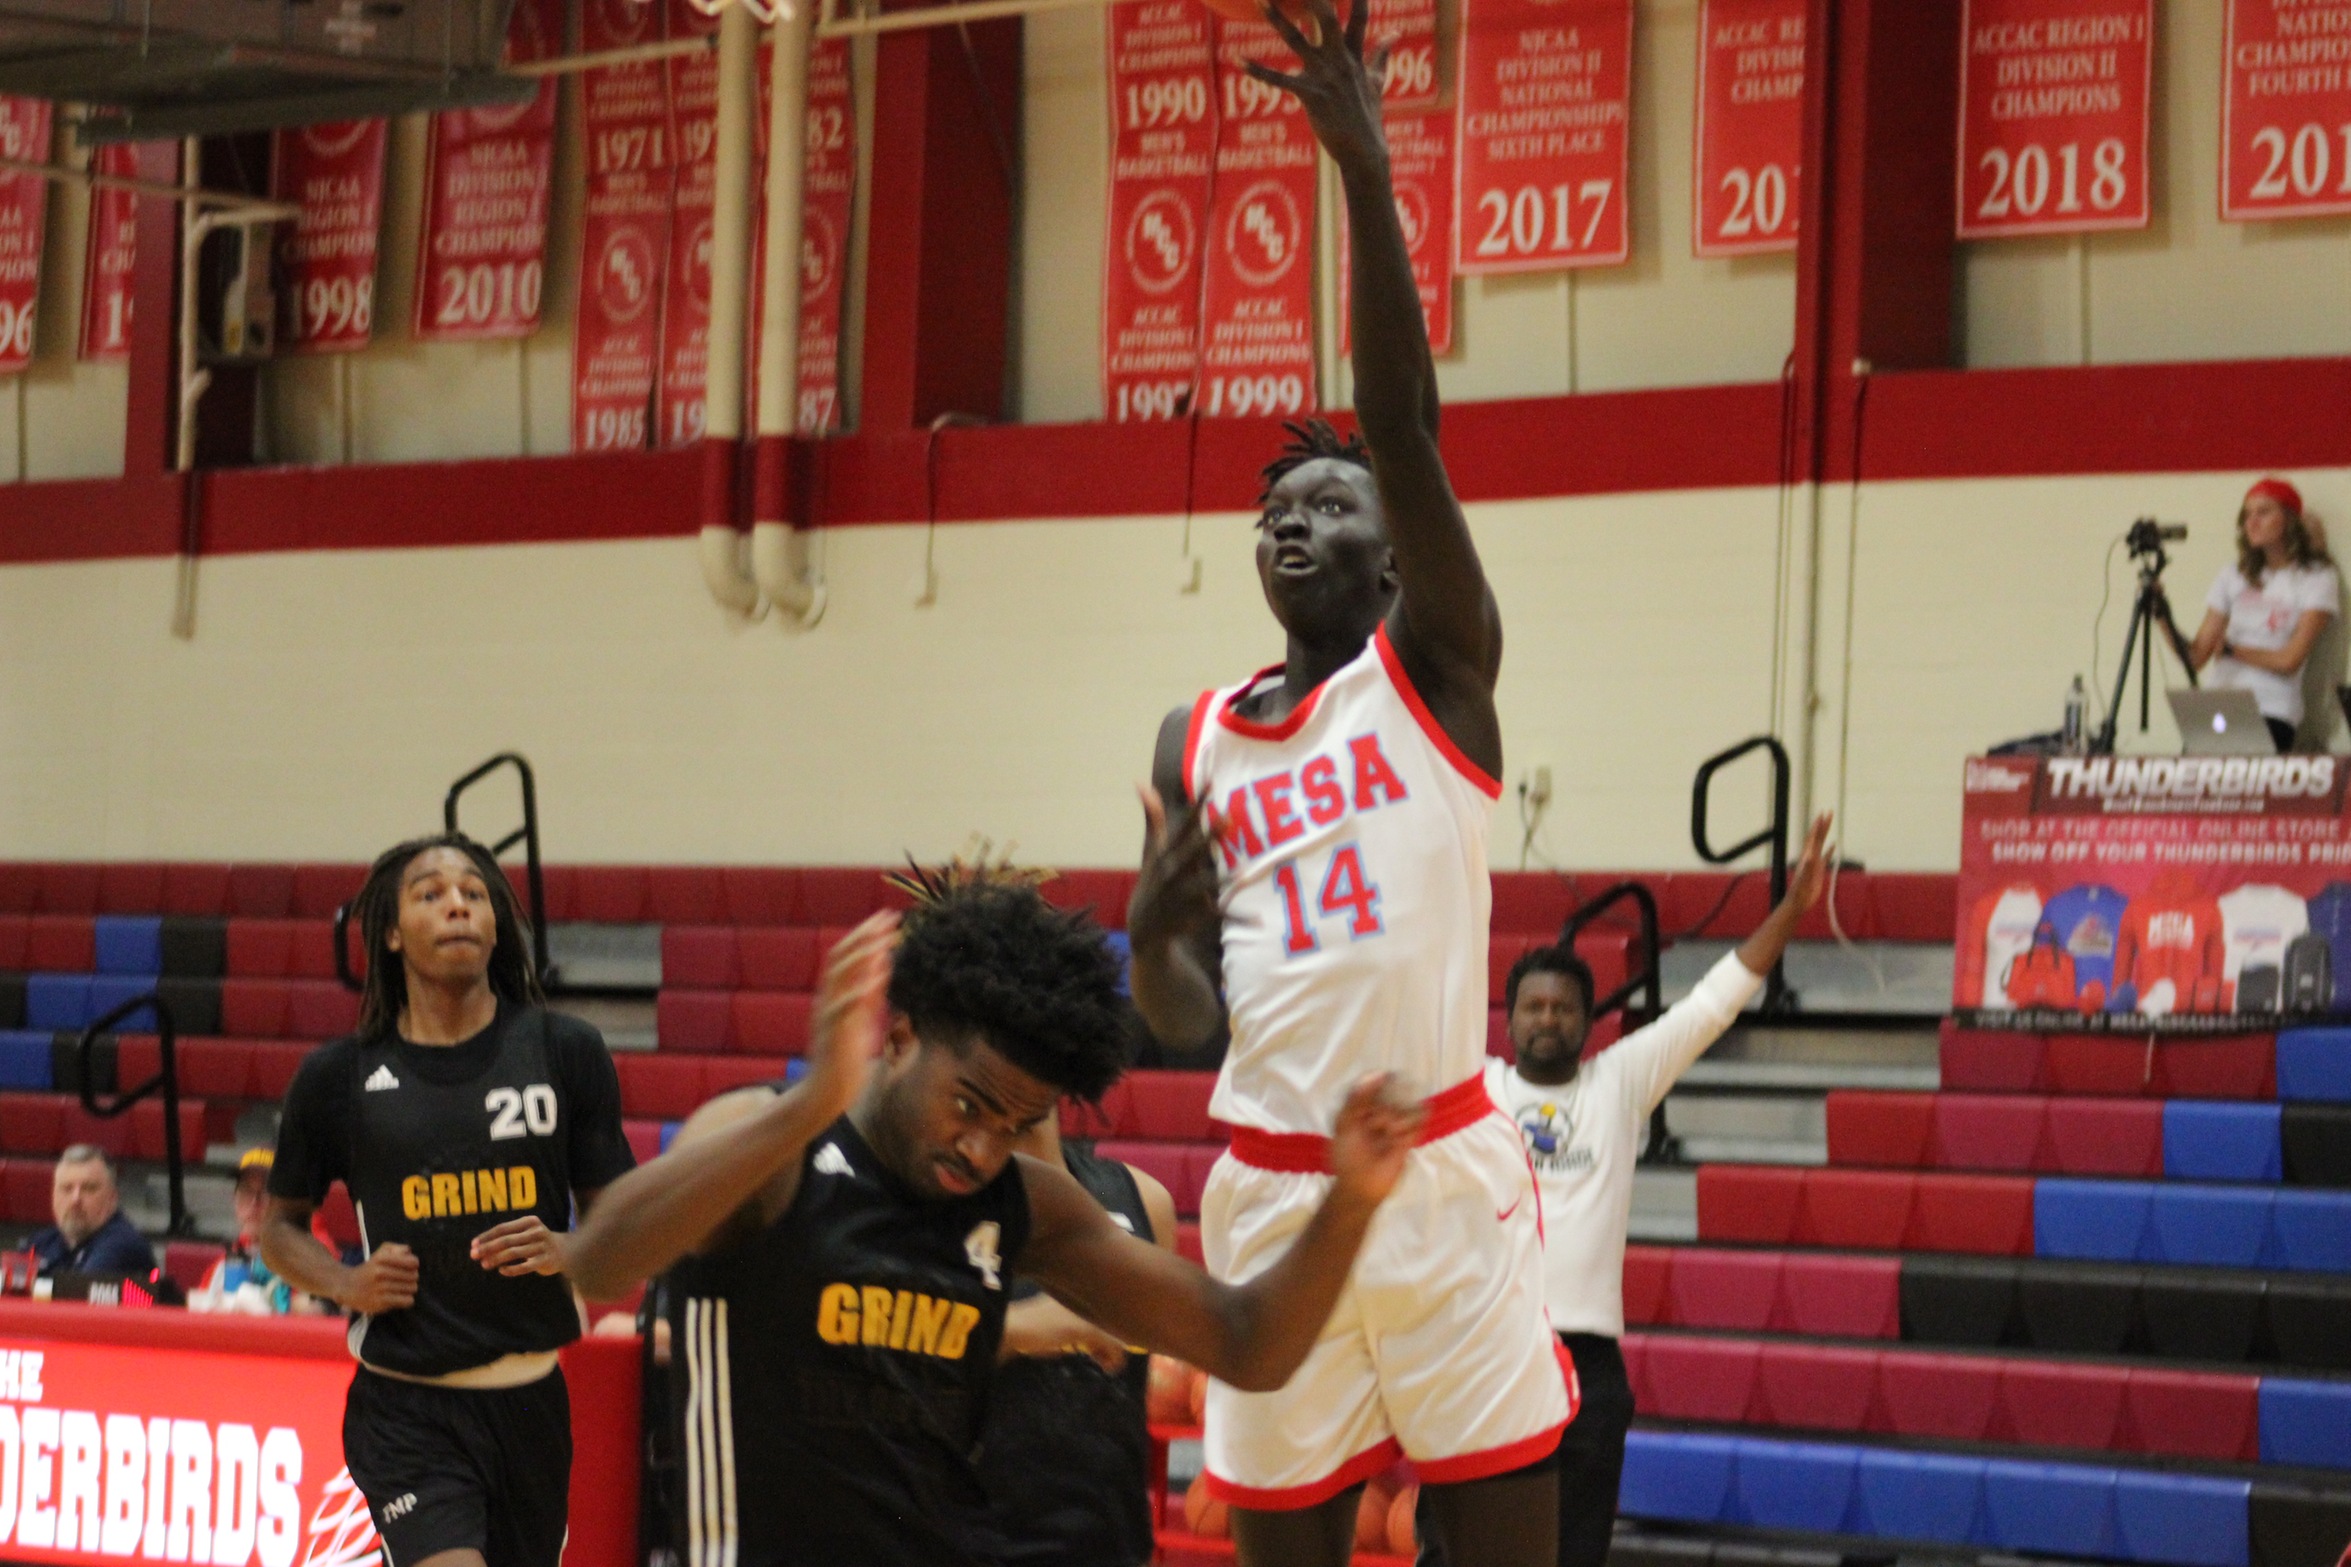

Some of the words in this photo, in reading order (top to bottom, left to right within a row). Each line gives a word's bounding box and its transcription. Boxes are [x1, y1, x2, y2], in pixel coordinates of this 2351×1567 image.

[2047, 14, 2131, 47] REGION
[1997, 52, 2095, 86] DIVISION
[1127, 76, 1207, 129] 1990
[1991, 82, 2121, 120] CHAMPIONS
[599, 125, 665, 173] 1971
[1719, 163, 1801, 238] 20
[1978, 137, 2127, 220] 2018
[1476, 178, 1613, 257] 2017
[436, 259, 542, 325] 2010
[1208, 374, 1304, 418] 1999
[1205, 730, 1410, 872] MESA
[2048, 756, 2335, 798] THUNDERBIRDS
[1991, 841, 2048, 864] SHOW
[2050, 841, 2090, 864] OFF
[2096, 841, 2147, 864] YOUR
[1272, 839, 1386, 960] 14
[484, 1082, 558, 1141] 20
[401, 1165, 538, 1222] GRIND
